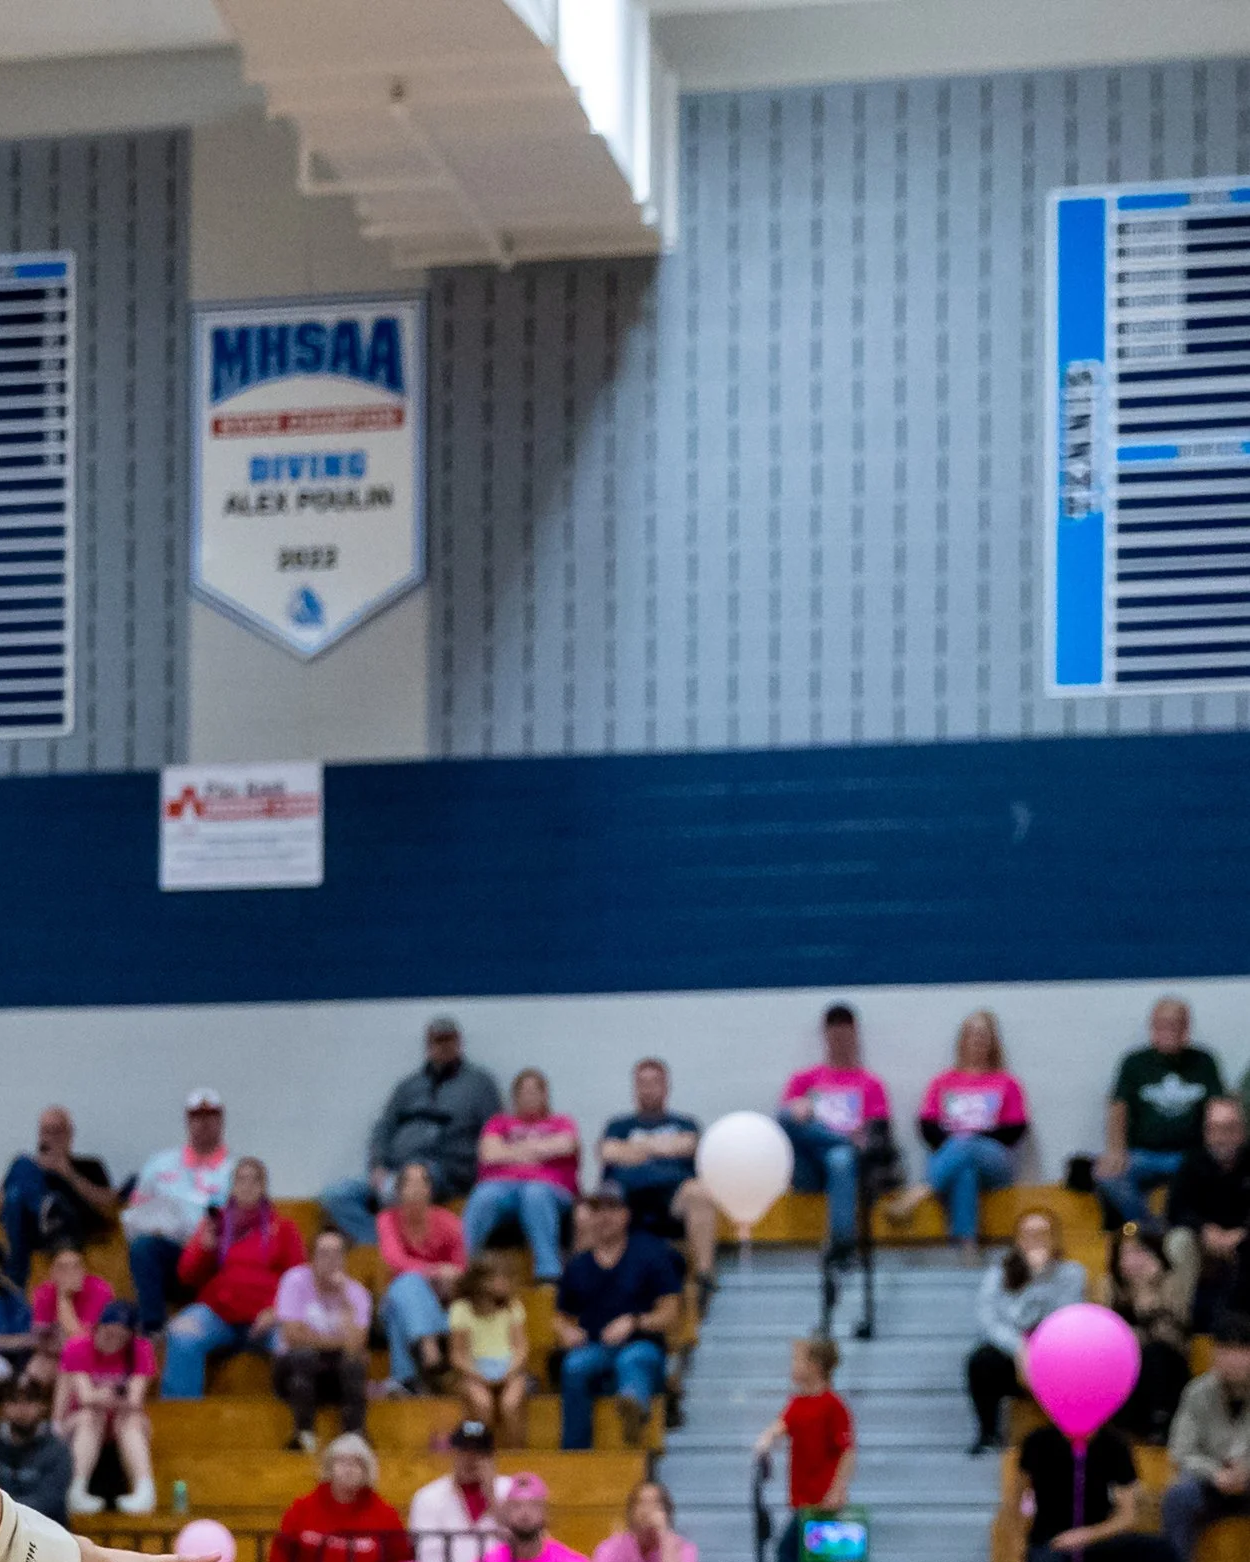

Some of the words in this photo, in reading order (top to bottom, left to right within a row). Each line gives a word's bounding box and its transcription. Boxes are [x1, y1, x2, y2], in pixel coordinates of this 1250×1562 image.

[211, 317, 407, 405] MHSAA
[249, 452, 366, 482] DIVING
[224, 490, 288, 515] ALEX
